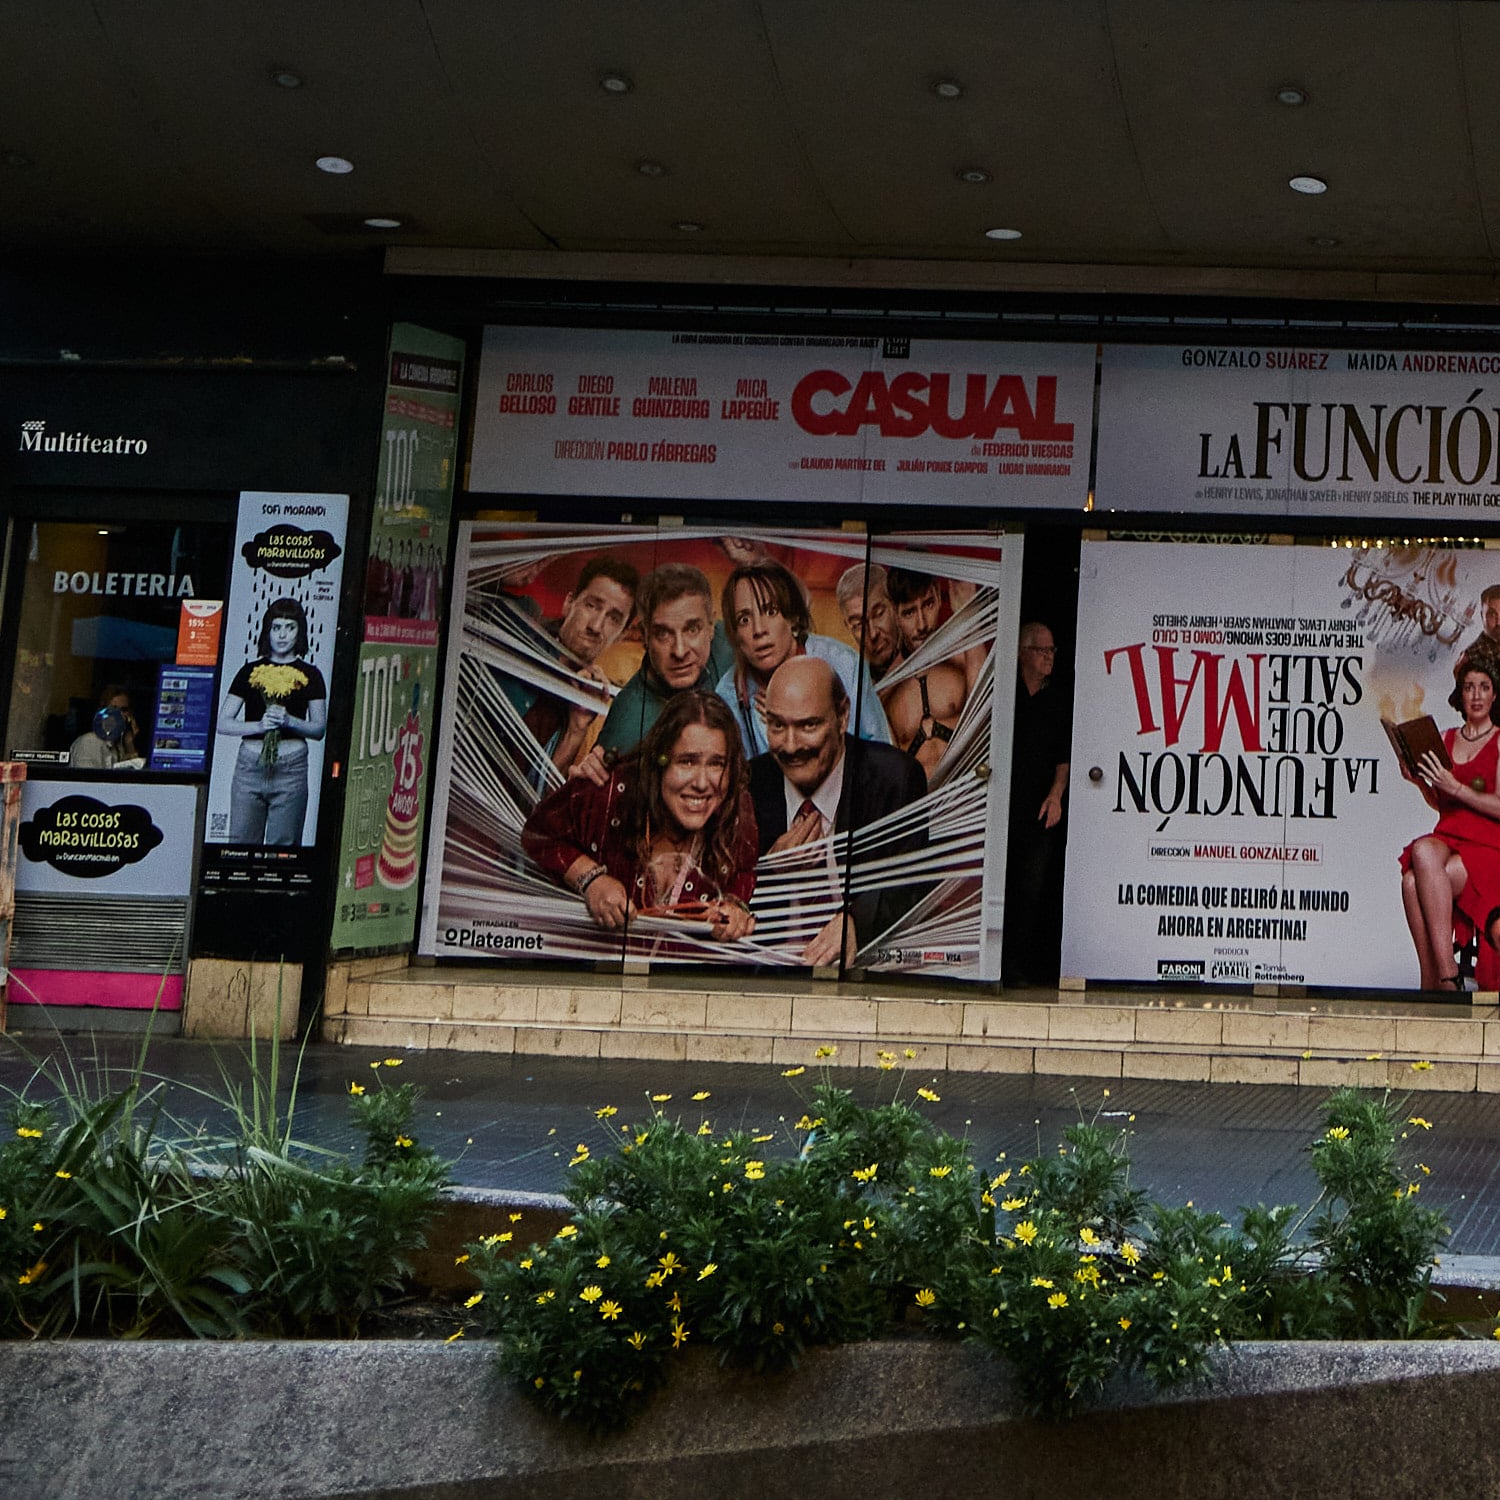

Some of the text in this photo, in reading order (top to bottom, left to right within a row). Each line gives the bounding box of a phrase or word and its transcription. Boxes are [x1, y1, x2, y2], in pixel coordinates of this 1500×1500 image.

[1182, 349, 1261, 368] GONZALO
[1347, 354, 1398, 372] MAIDA
[500, 394, 779, 421] BELLOSO GENTILE GUINZBURG LAPEGÜE
[791, 370, 1075, 441] CASUAL
[19, 431, 148, 455] Multiteatro
[1198, 432, 1247, 480] LA
[54, 571, 194, 597] BOLETERIA
[1118, 885, 1349, 912] LA COMEDIA QUE DELIRÓ AL MUNDO
[1158, 916, 1306, 940] AHORA EN ARGENTINA!
